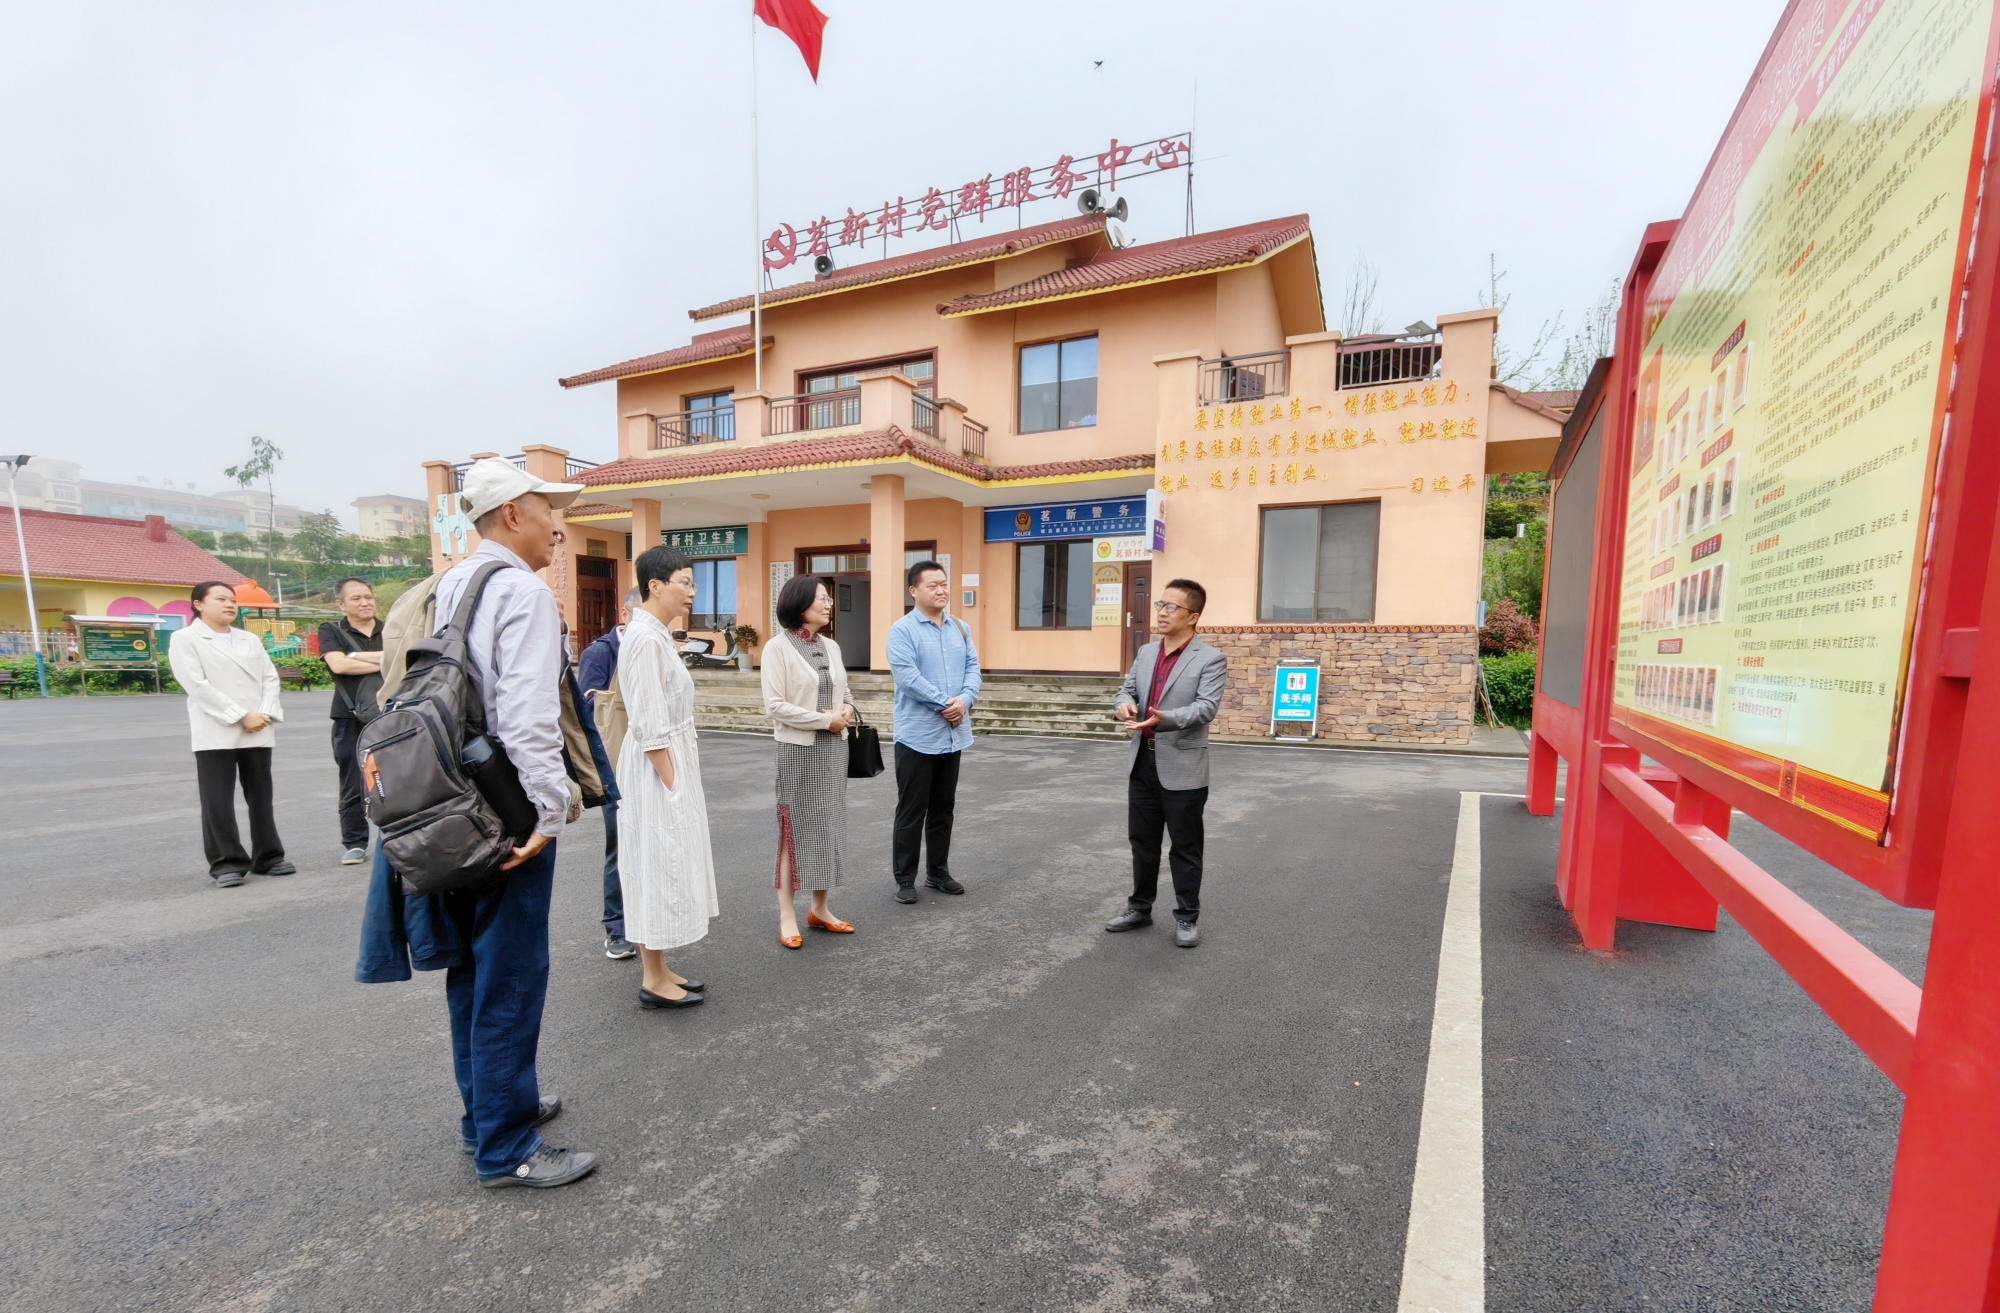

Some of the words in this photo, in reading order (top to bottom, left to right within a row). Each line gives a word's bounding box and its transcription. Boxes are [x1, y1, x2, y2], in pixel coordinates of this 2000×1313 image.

[804, 138, 1190, 258] 茗新村党群服务中心
[1192, 379, 1474, 432] 要坚持就业第一，增强就业能力，
[1160, 416, 1480, 464] 引导各族群众有序进城就业、就地就近
[1040, 504, 1130, 521] 茗新警务
[1280, 693, 1312, 704] 洗手间
